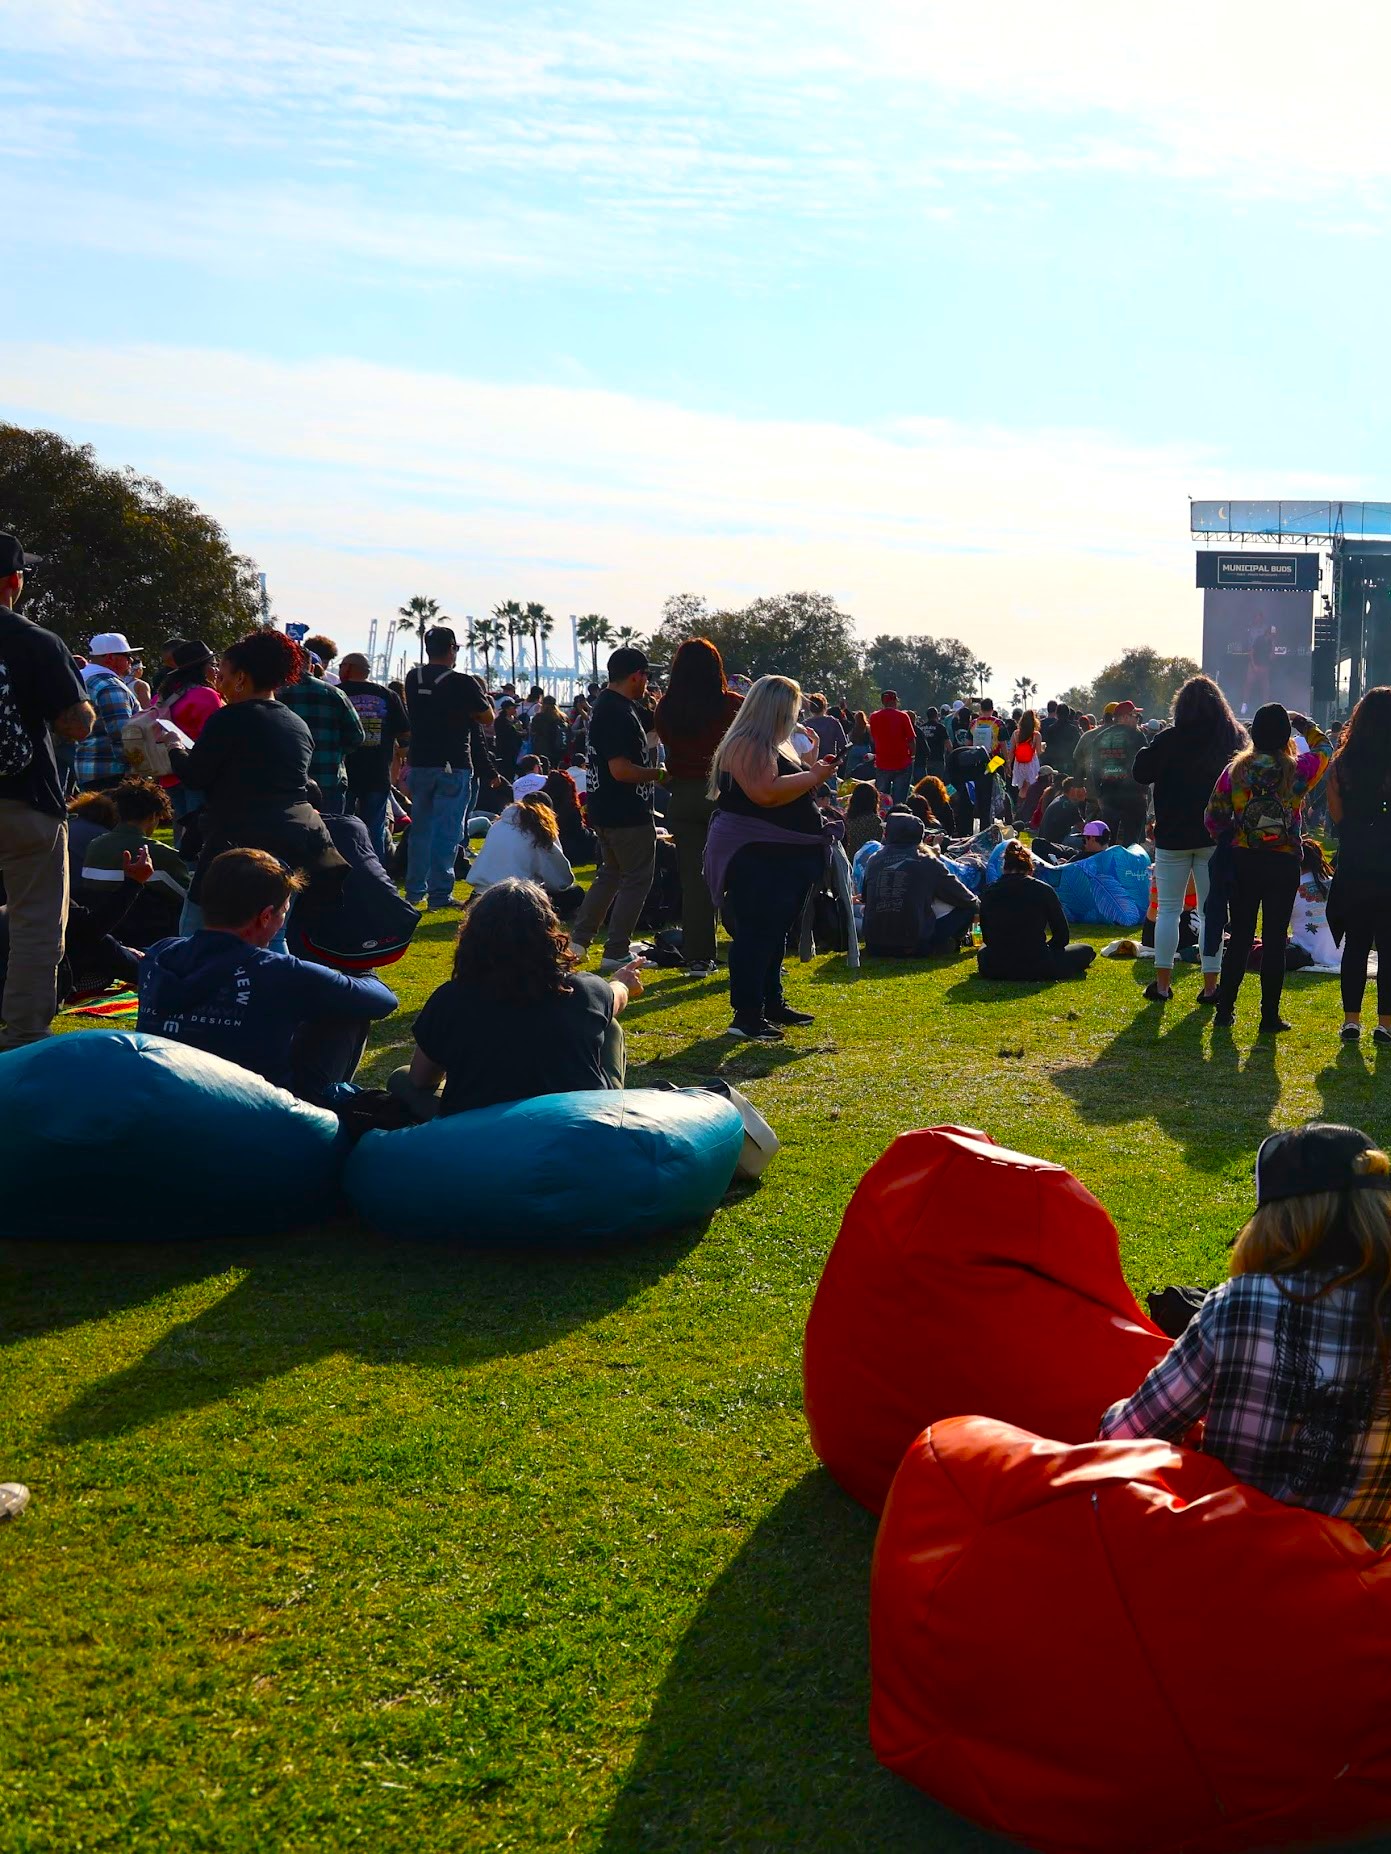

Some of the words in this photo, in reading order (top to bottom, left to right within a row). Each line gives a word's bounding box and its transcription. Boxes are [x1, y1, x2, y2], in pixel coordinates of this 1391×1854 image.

[1222, 564, 1270, 573] MUNICIPAL
[1270, 565, 1292, 573] BUDS
[191, 1014, 242, 1027] DESIGN
